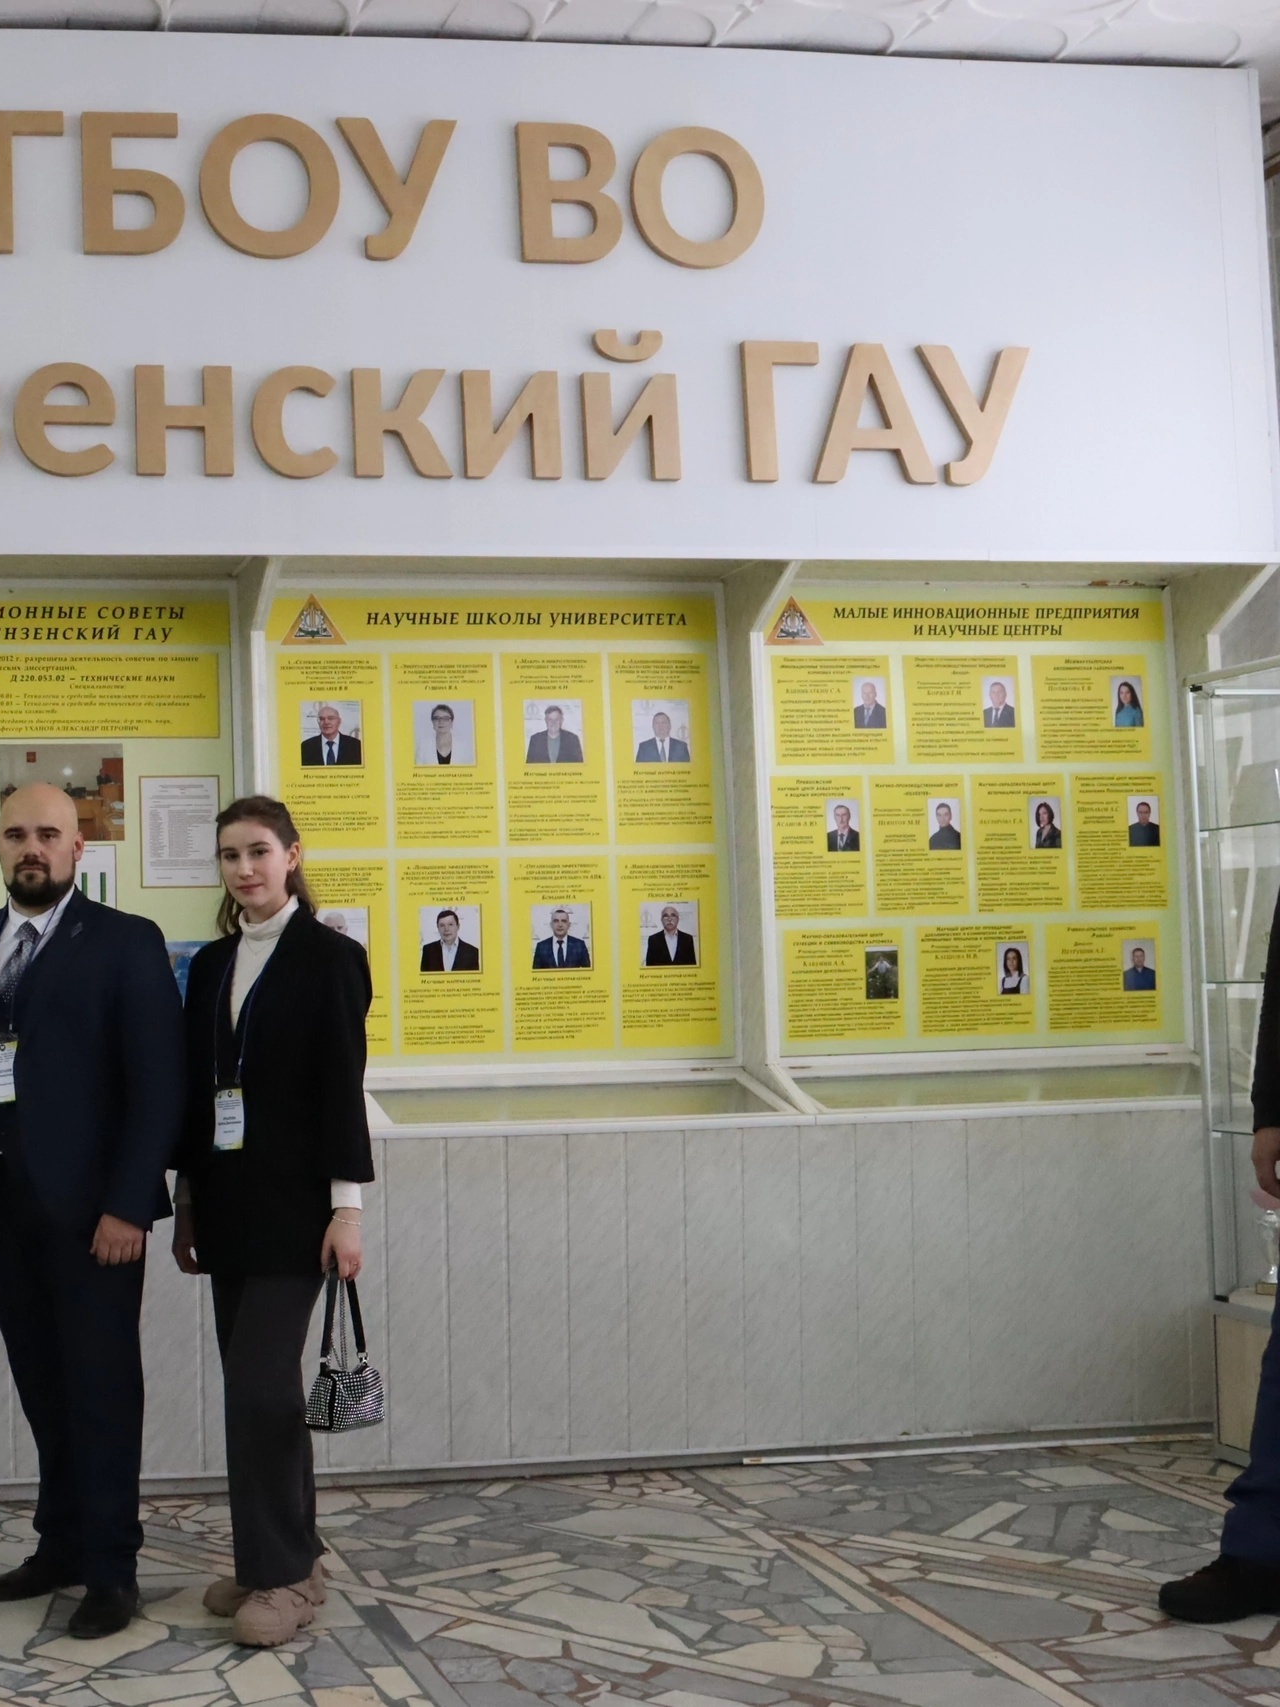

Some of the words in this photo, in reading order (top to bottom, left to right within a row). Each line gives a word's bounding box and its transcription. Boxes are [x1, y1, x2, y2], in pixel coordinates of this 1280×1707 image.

[517, 121, 764, 268] ВО
[739, 340, 1031, 486] ГАУ
[98, 606, 185, 620] СОВЕТЫ
[367, 611, 458, 626] НАУЧНЫЕ
[467, 611, 541, 626] ШКОЛЫ
[550, 611, 687, 626] УНИВЕРСИТЕТА
[834, 607, 888, 619] МАЛЫЕ
[893, 607, 1029, 620] ИННОВАЦИОННЫЕ
[1036, 607, 1139, 620] ПРЕДПРИЯТИЯ
[134, 627, 172, 642] ГАУ
[914, 624, 923, 636] И
[928, 624, 999, 636] НАУЧНЫЕ
[1004, 624, 1062, 637] ЦЕНТРЫ
[10, 675, 17, 683] Д
[20, 675, 65, 683] 220.053.02
